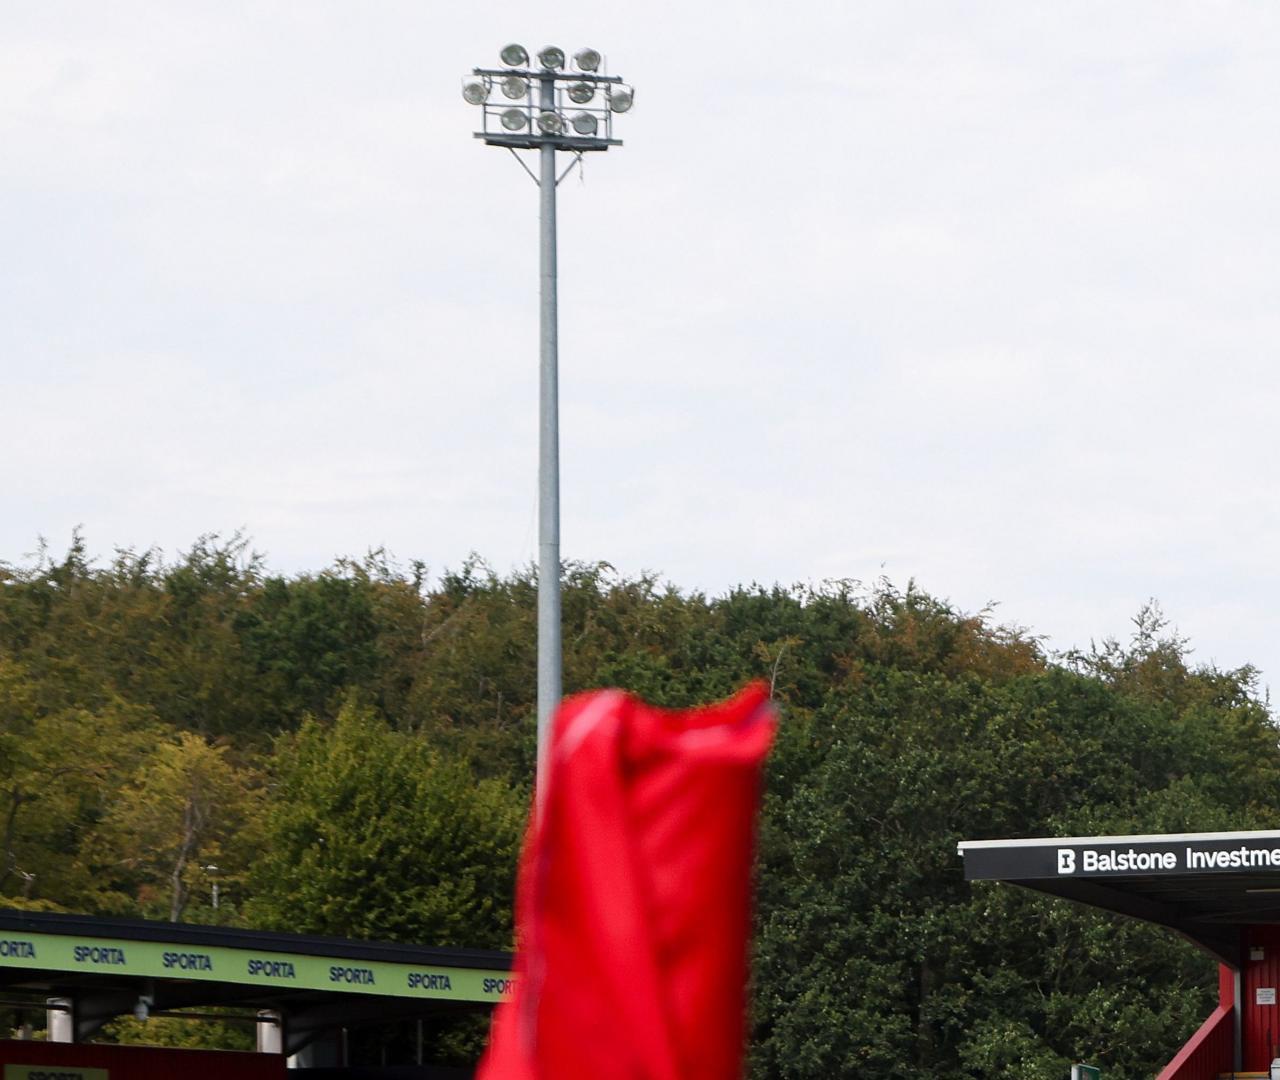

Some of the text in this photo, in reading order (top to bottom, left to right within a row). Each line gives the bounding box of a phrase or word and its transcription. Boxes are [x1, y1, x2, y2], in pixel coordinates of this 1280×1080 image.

[1083, 849, 1177, 871] Balstone
[73, 945, 126, 966] SPORTA
[162, 952, 213, 971] SPORTA
[247, 959, 296, 979] SPORTA
[329, 966, 375, 986] SPORTA
[407, 973, 452, 990] SPORTA
[482, 979, 518, 995] SPORT
